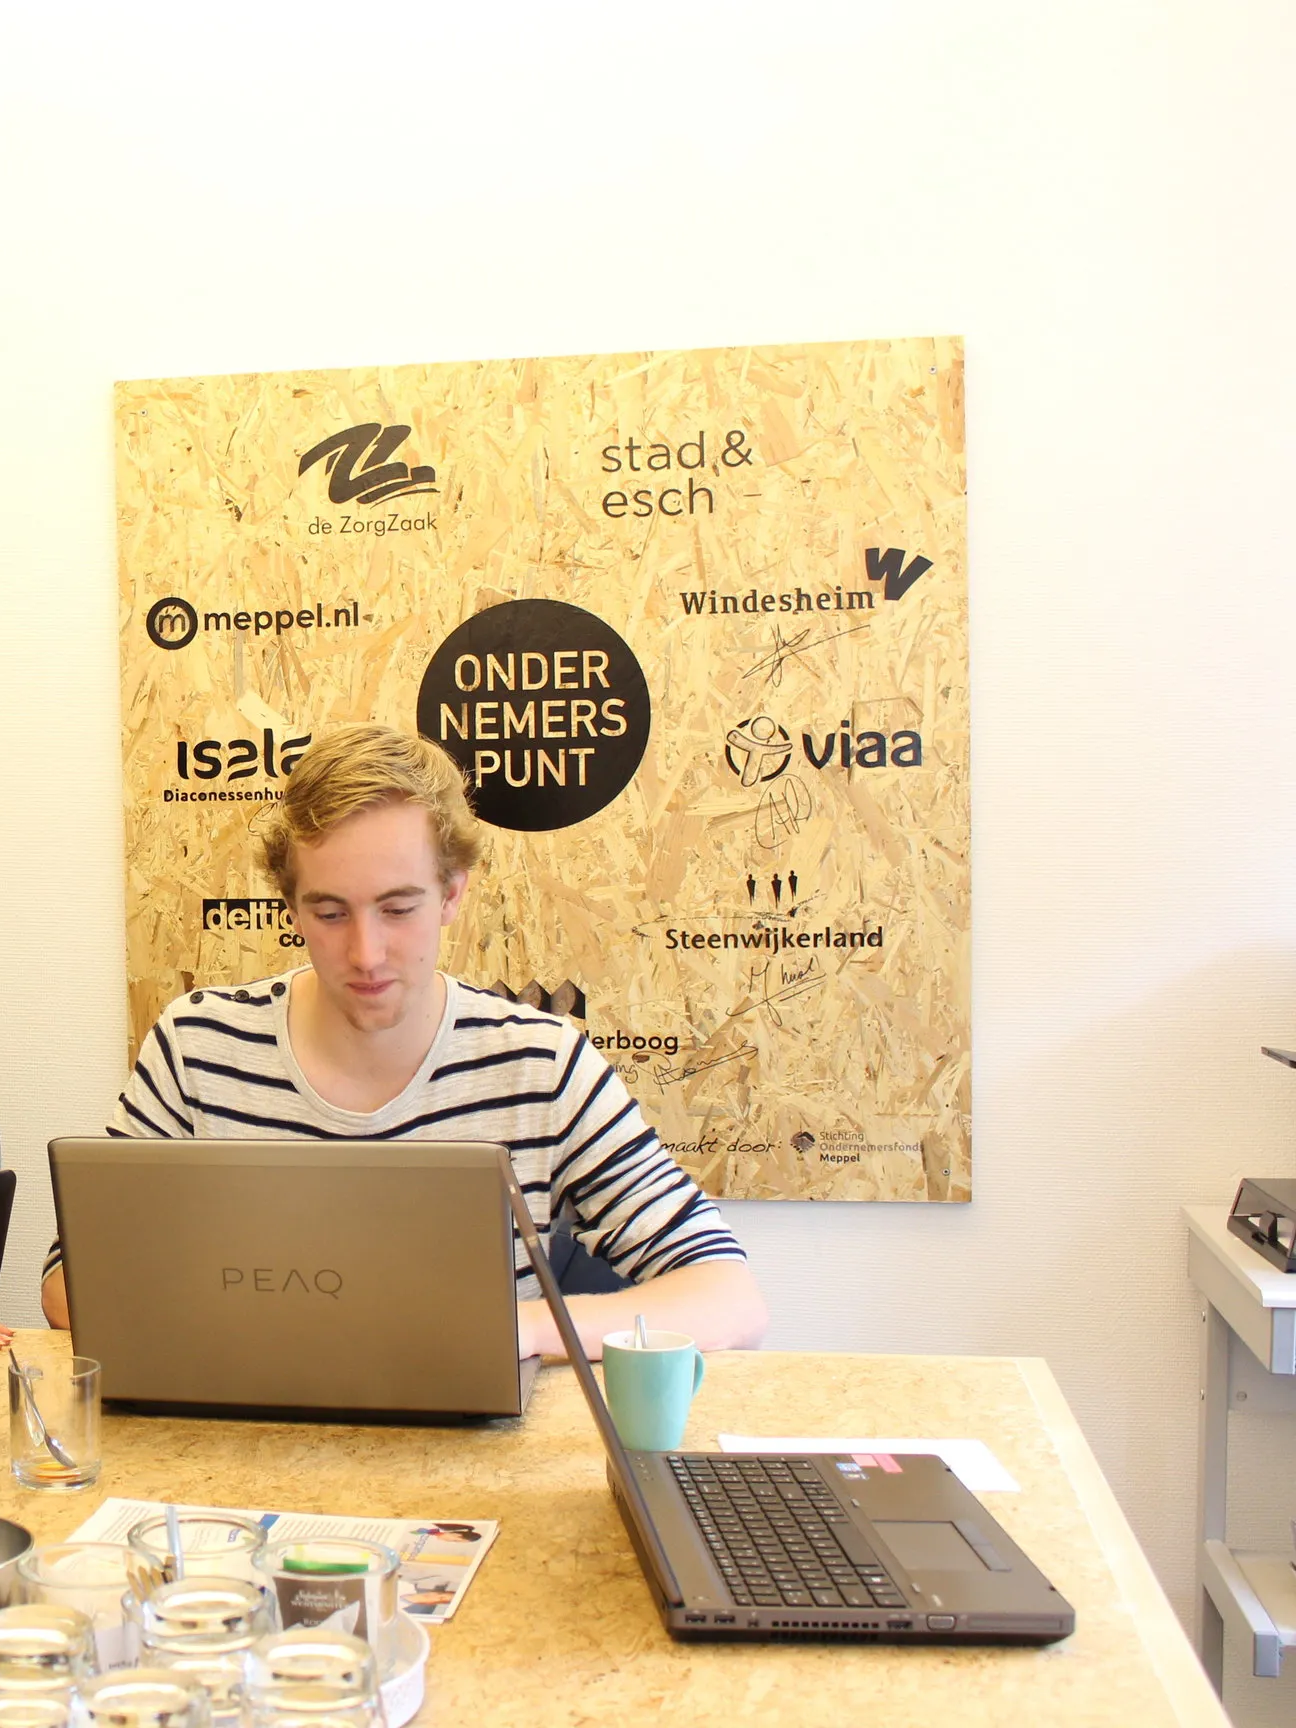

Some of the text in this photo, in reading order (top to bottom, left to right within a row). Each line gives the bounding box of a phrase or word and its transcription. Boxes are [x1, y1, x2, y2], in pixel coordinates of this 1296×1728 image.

[602, 430, 753, 472] stad &
[602, 477, 713, 518] esch
[308, 511, 438, 537] de ZorgZaak
[679, 585, 875, 615] Windesheim
[204, 602, 359, 636] meppel.nl
[454, 649, 611, 692] ONDER
[440, 698, 628, 741] NEMERS
[802, 719, 923, 771] viaa
[475, 747, 595, 788] PUNT
[665, 925, 884, 955] Steenwijkerland
[726, 1137, 782, 1153] door:
[819, 1131, 865, 1143] Stichting
[819, 1142, 924, 1153] Ondernemersfonds
[819, 1153, 861, 1164] Meppel
